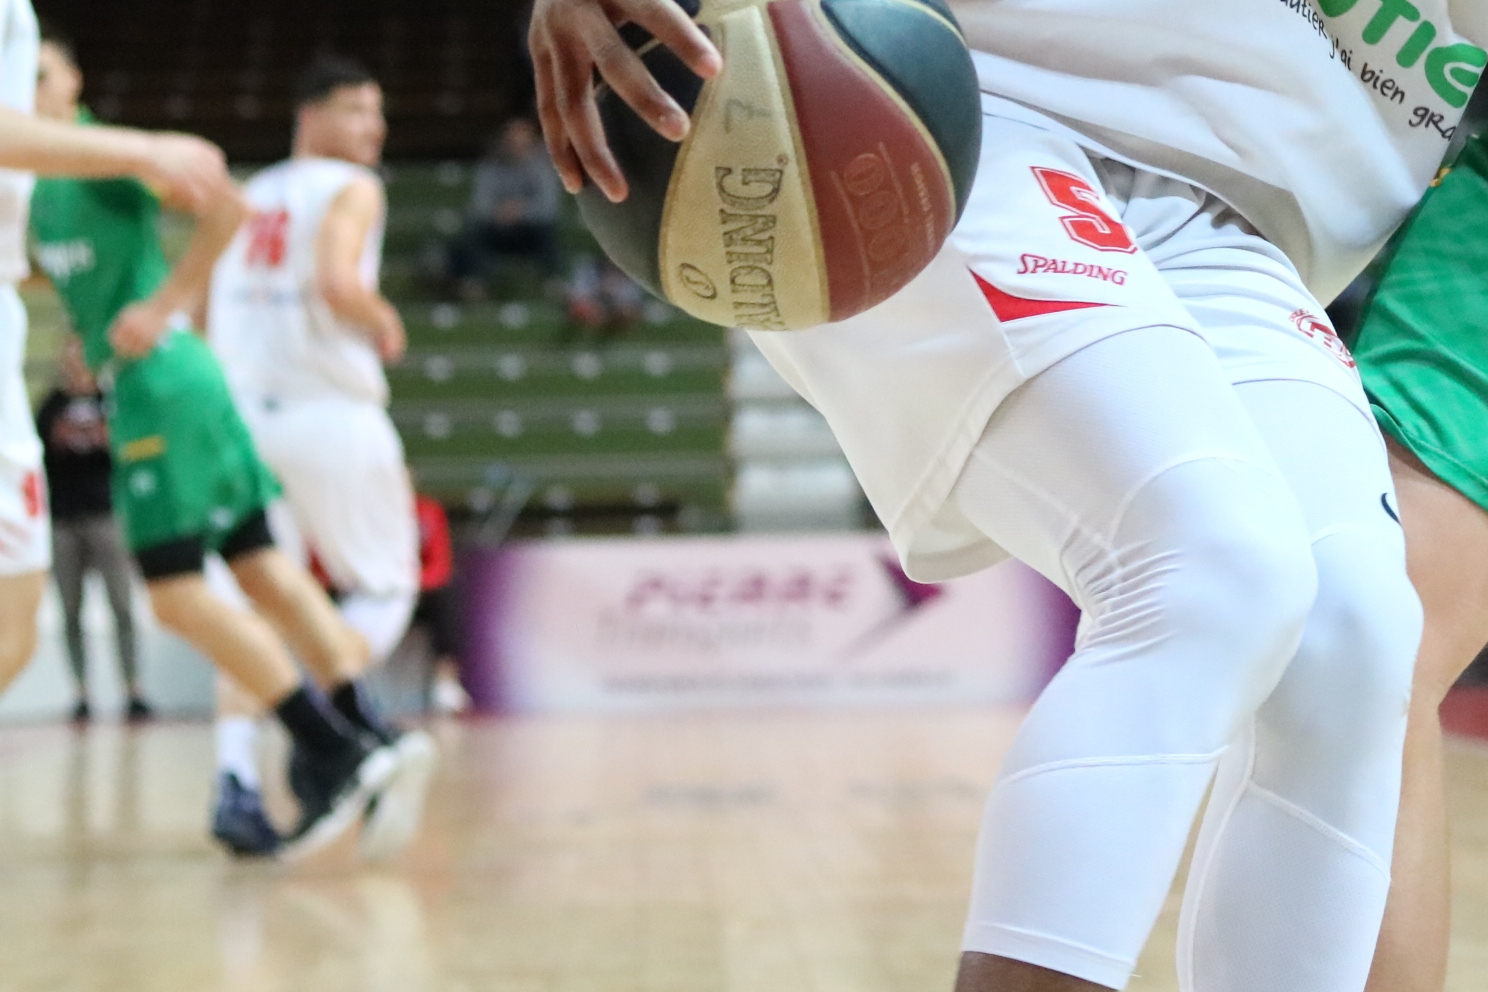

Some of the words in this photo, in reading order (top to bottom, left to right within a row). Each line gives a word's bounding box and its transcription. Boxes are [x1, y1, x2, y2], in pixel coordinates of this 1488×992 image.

[1360, 62, 1406, 105] bien
[1028, 165, 1138, 255] 5
[1016, 252, 1128, 286] SPALDING
